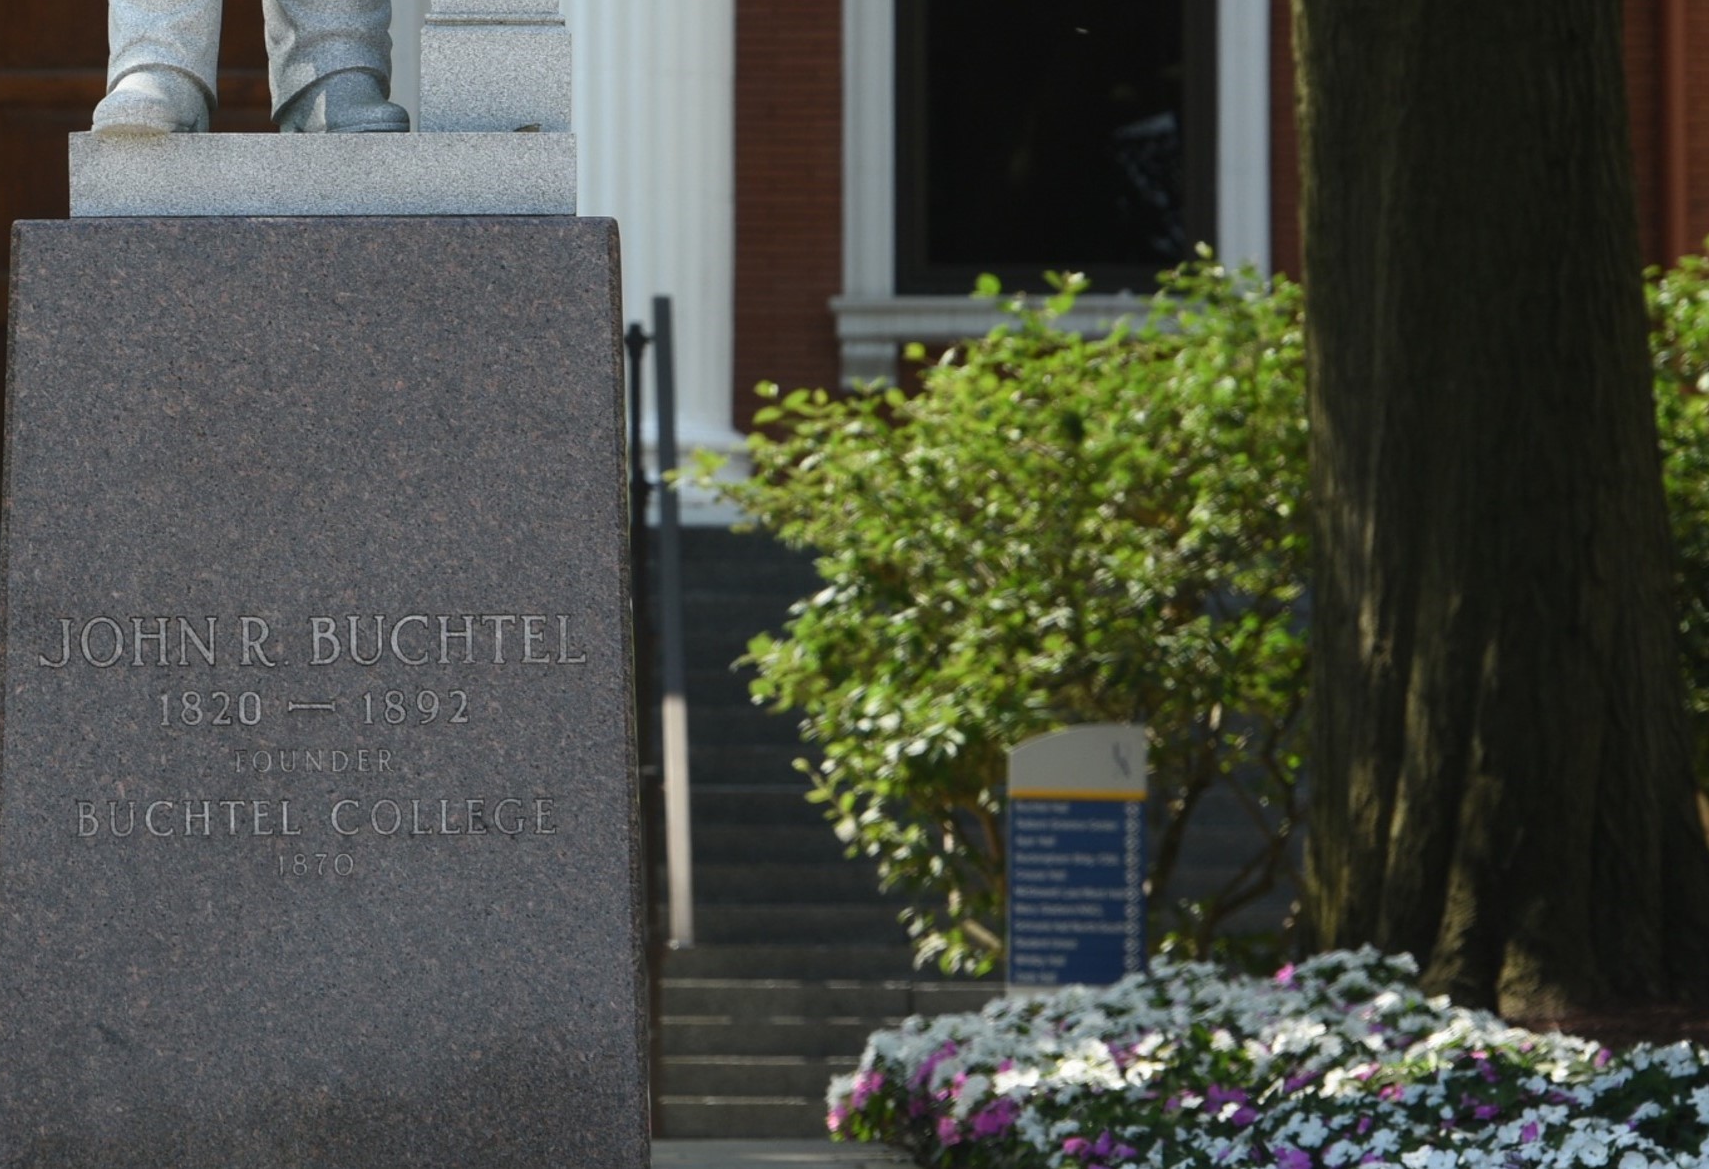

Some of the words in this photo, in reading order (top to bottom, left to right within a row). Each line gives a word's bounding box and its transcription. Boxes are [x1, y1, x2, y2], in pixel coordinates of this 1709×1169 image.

[39, 616, 217, 668] JOHN
[239, 616, 291, 668] R.
[309, 614, 588, 666] BUCHTEL
[159, 690, 263, 727] 1820
[362, 689, 471, 726] 1892
[235, 749, 395, 774] FOUNDER
[76, 799, 303, 838] BUCHTEL
[329, 797, 558, 837] COLLEGE
[278, 852, 355, 877] 1870
